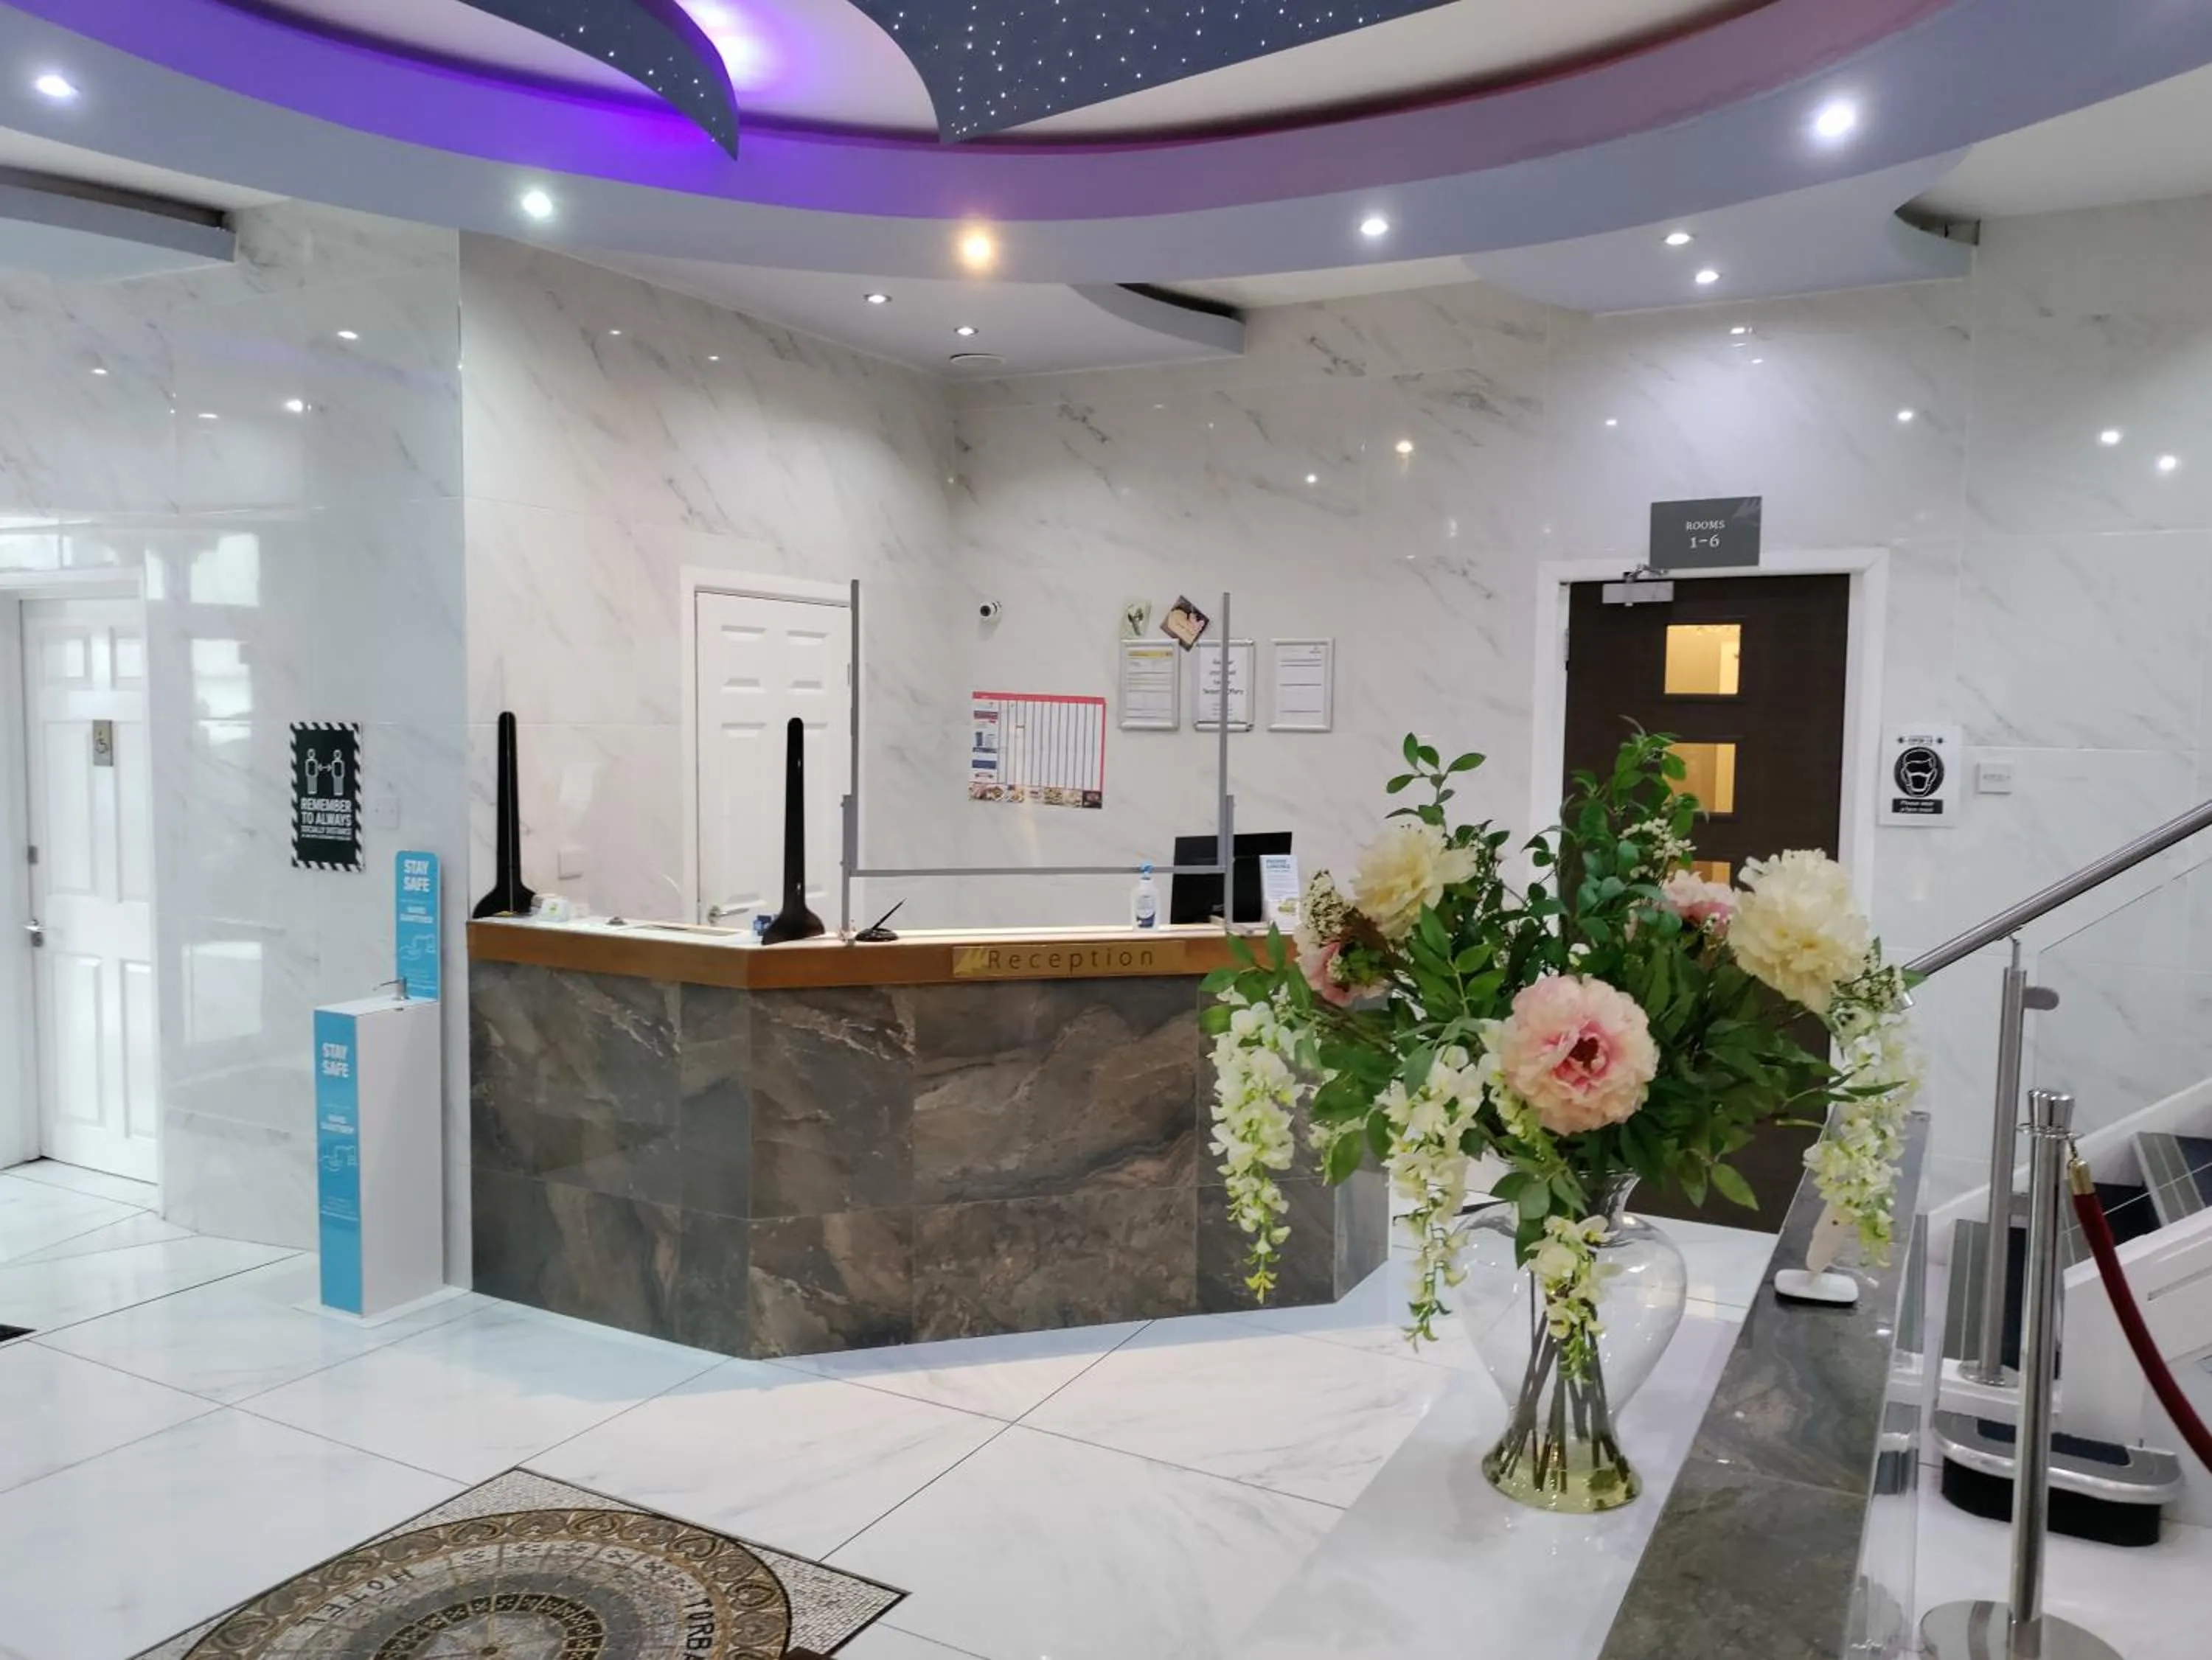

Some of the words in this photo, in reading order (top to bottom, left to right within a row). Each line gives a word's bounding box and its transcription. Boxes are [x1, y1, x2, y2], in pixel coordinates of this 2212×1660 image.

[1686, 520, 1726, 531] ROOMS
[1690, 534, 1720, 548] 1-6
[300, 798, 352, 812] REMEMBER
[301, 812, 314, 825] TO
[315, 812, 352, 826] ALWAYS
[403, 859, 430, 875] STAY
[403, 876, 431, 893] SAFE
[988, 948, 1154, 974] Reception
[322, 1042, 348, 1060] STAY
[322, 1060, 349, 1078] SAFE
[296, 1568, 414, 1627] HOTEL
